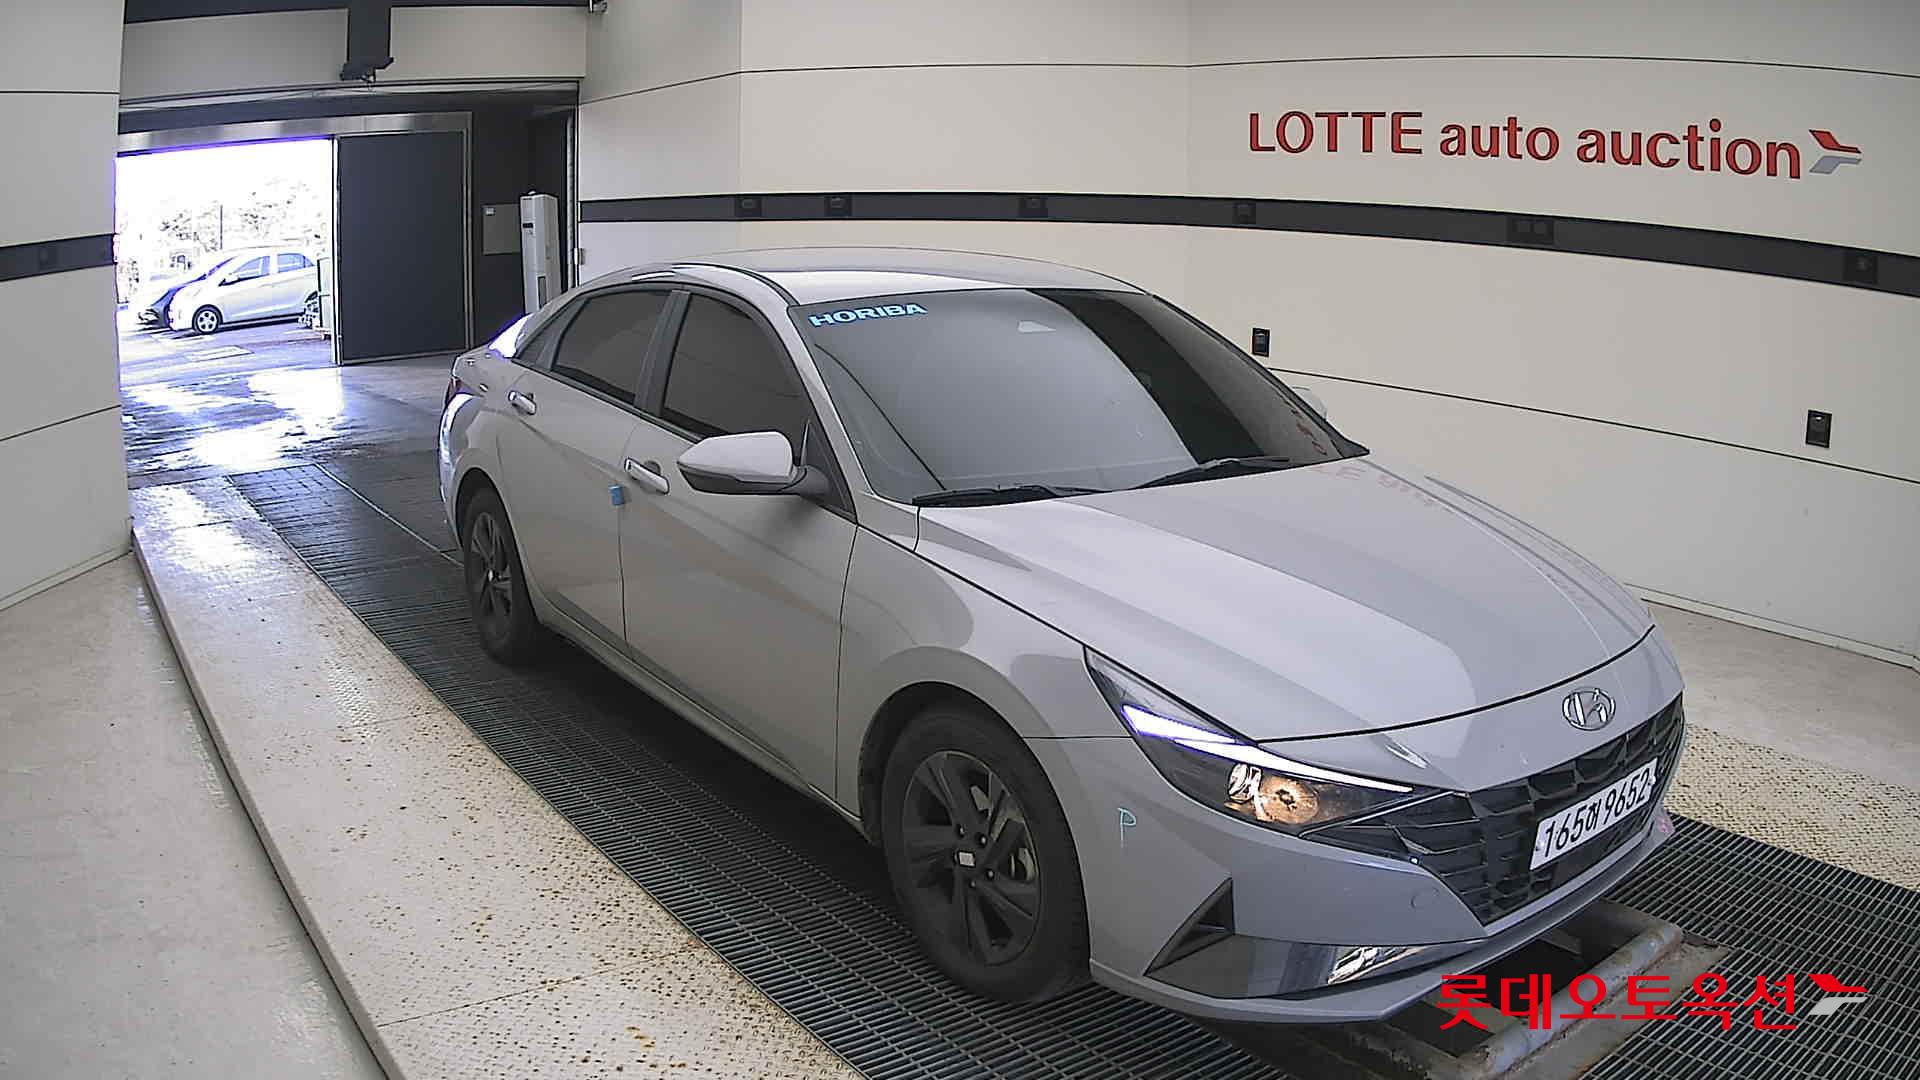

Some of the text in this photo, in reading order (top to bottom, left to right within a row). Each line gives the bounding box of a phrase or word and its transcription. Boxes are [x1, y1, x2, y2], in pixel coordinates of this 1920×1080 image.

[1249, 111, 1802, 179] LOTTE auto auction
[807, 303, 929, 327] HORIBA
